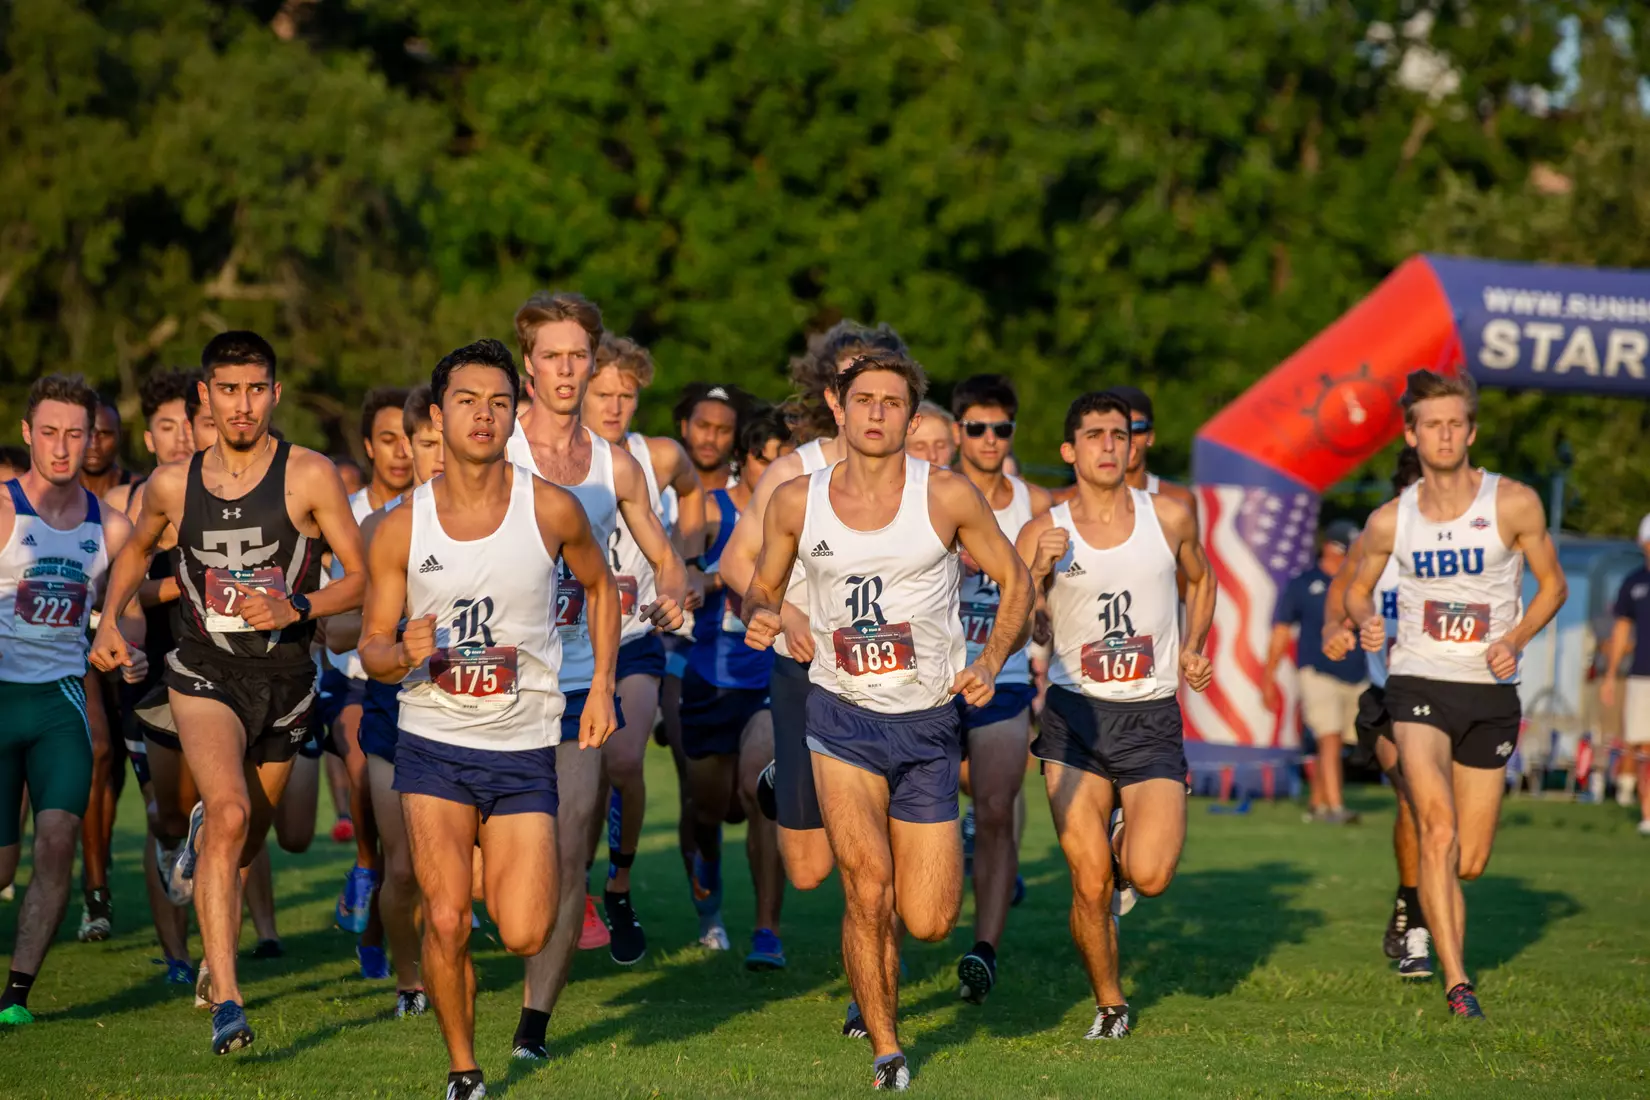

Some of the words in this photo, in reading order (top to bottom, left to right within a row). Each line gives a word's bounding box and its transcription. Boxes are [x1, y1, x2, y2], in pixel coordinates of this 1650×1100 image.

[1483, 286, 1650, 324] WWW.RUNH
[1479, 318, 1648, 379] STAR
[419, 565, 443, 573] adidas
[1412, 548, 1485, 578] HBU
[32, 596, 72, 624] 222
[845, 575, 888, 628] R
[1097, 589, 1136, 640] R
[451, 596, 497, 648] R
[960, 615, 995, 640] 171
[1437, 614, 1476, 641] 149
[851, 641, 897, 672] 183
[1099, 652, 1139, 680] 167
[450, 664, 498, 693] 175
